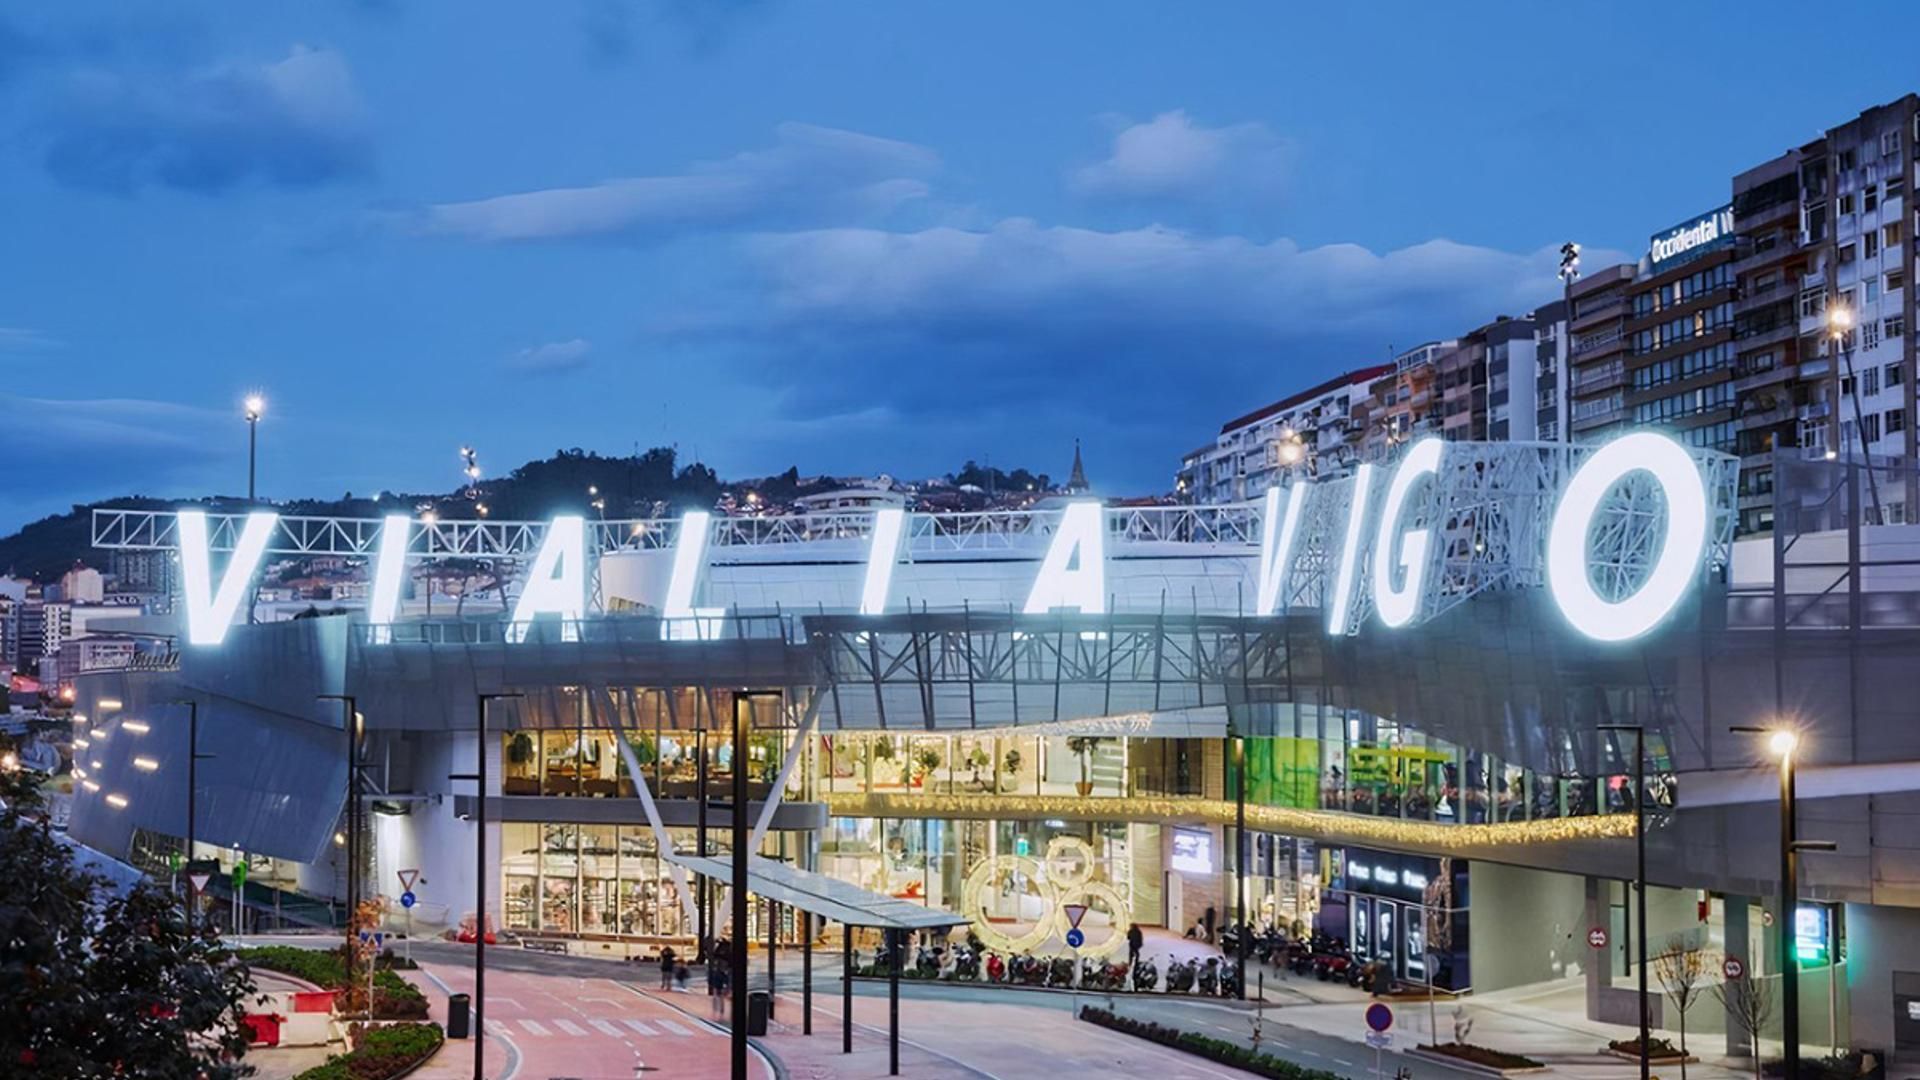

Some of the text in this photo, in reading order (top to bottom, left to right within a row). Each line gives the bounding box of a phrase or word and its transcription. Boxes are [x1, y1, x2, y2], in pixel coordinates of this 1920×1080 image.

[1652, 213, 1718, 263] Occidental
[177, 432, 1708, 644] VIALIA VIGO
